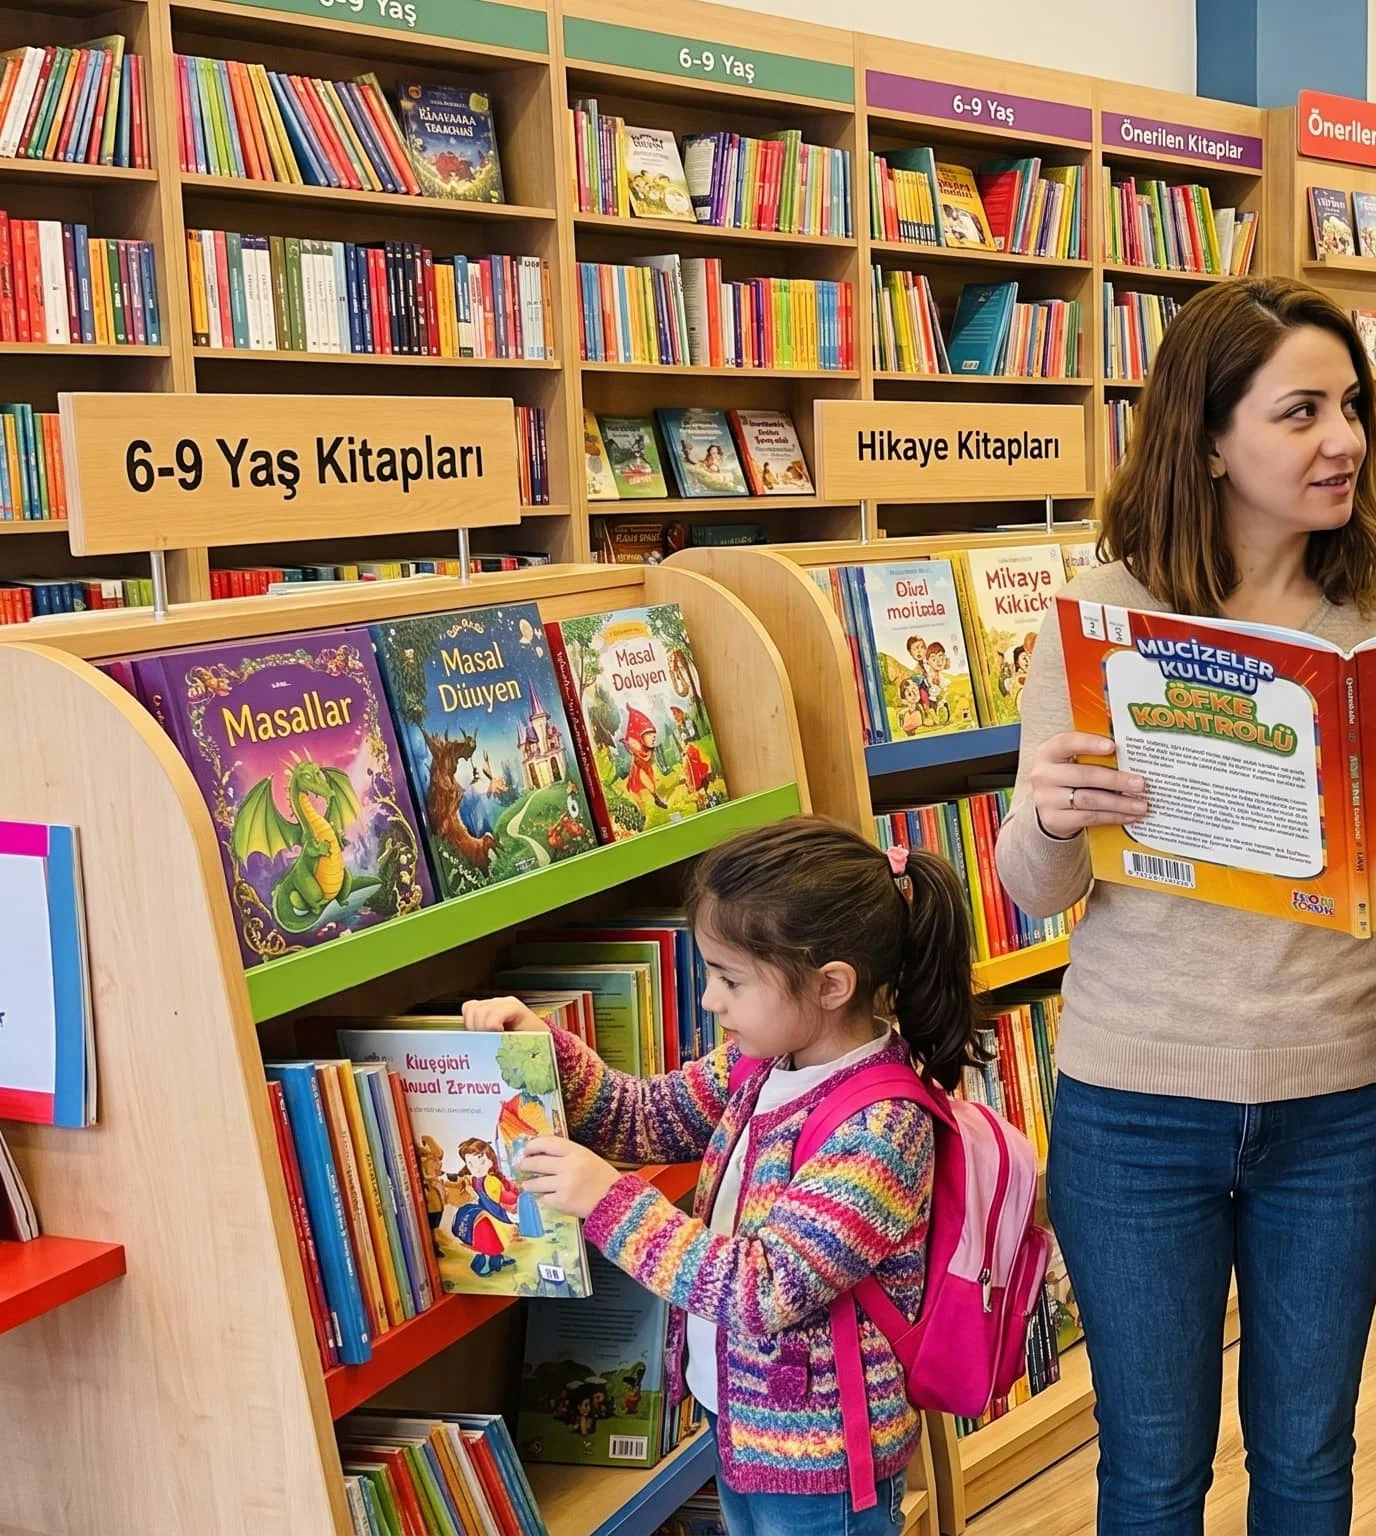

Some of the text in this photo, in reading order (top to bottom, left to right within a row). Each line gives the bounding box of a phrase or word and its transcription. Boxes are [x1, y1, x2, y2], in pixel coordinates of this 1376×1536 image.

[377, 0, 417, 27] Yaş
[679, 48, 755, 83] 6-9 Yaş
[953, 95, 1015, 126] 6-9 Yaş
[1121, 119, 1243, 160] Önerilen Kitaplar
[126, 434, 484, 500] 6-9 Yaş Kitapları
[857, 430, 1060, 468] Hikaye Kitapları
[440, 641, 505, 677] Masal
[615, 643, 656, 668] Masal
[1136, 638, 1275, 679] MUCİZELER
[1160, 659, 1257, 692] KULÜBÜ
[222, 691, 352, 747] Masallar
[1167, 682, 1254, 720] ÖFKE
[1131, 704, 1294, 752] KONTROLÜ
